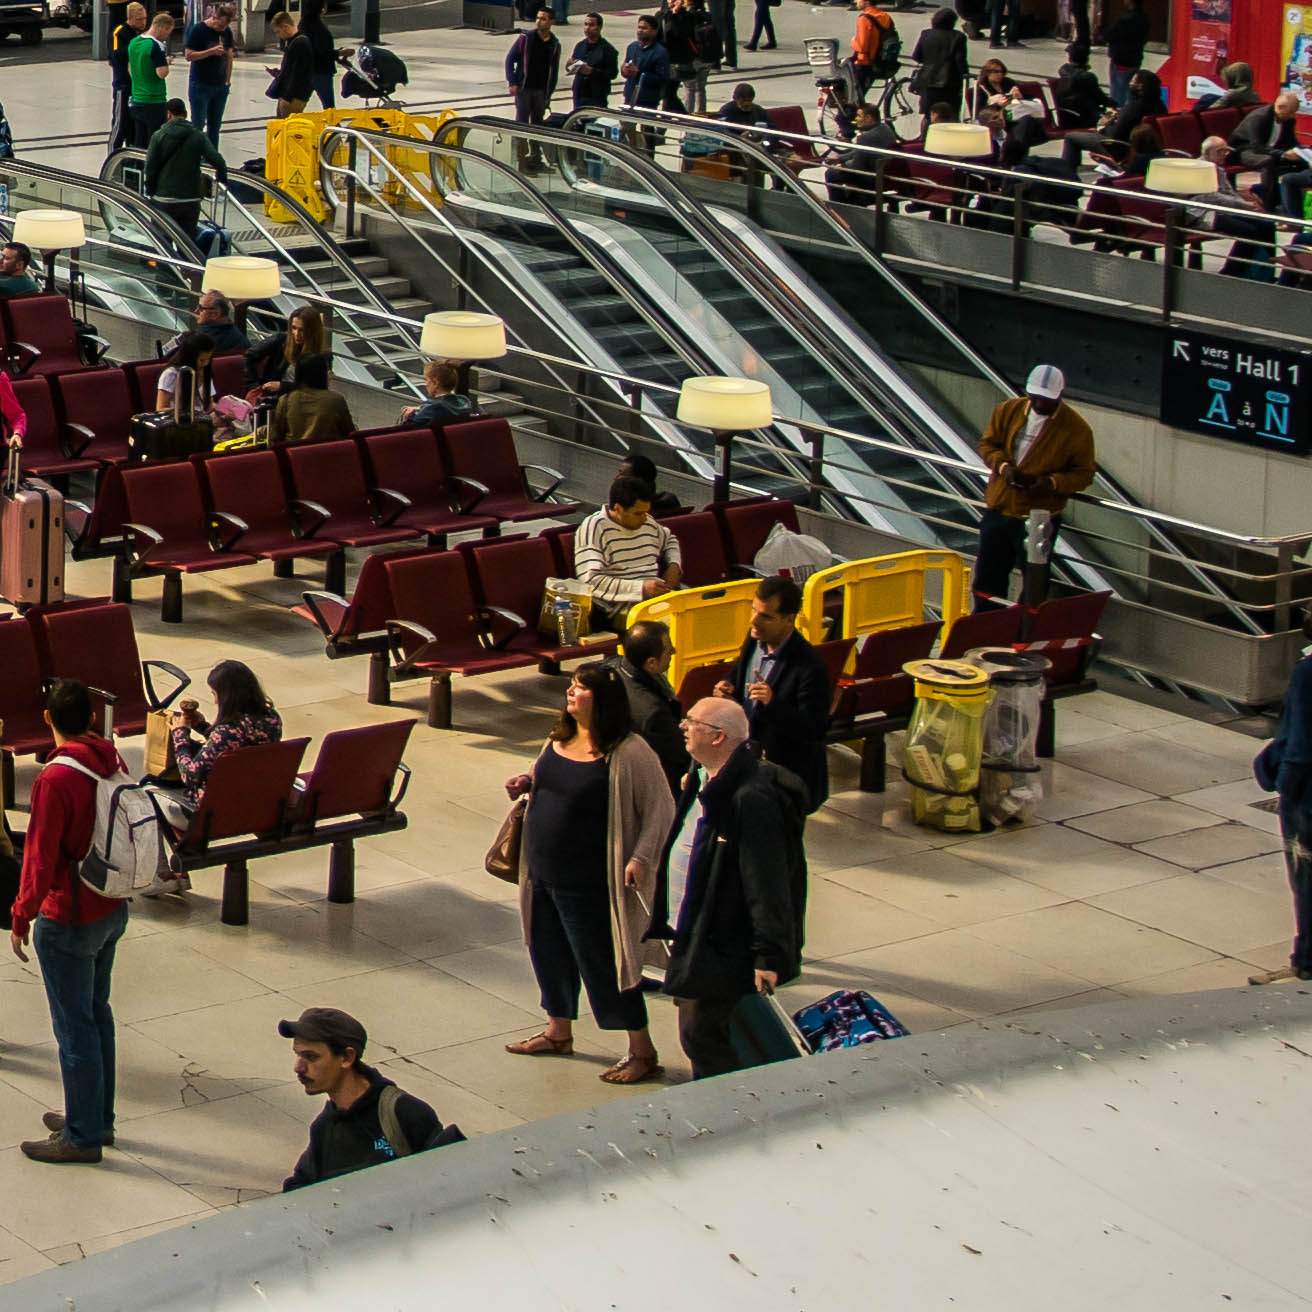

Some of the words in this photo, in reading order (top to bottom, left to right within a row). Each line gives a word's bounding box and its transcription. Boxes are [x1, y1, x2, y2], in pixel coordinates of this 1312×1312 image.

[1201, 346, 1229, 360] vers
[1236, 353, 1281, 382] Hall
[1287, 365, 1299, 385] 1
[1206, 392, 1229, 423] A
[1265, 403, 1289, 435] N
